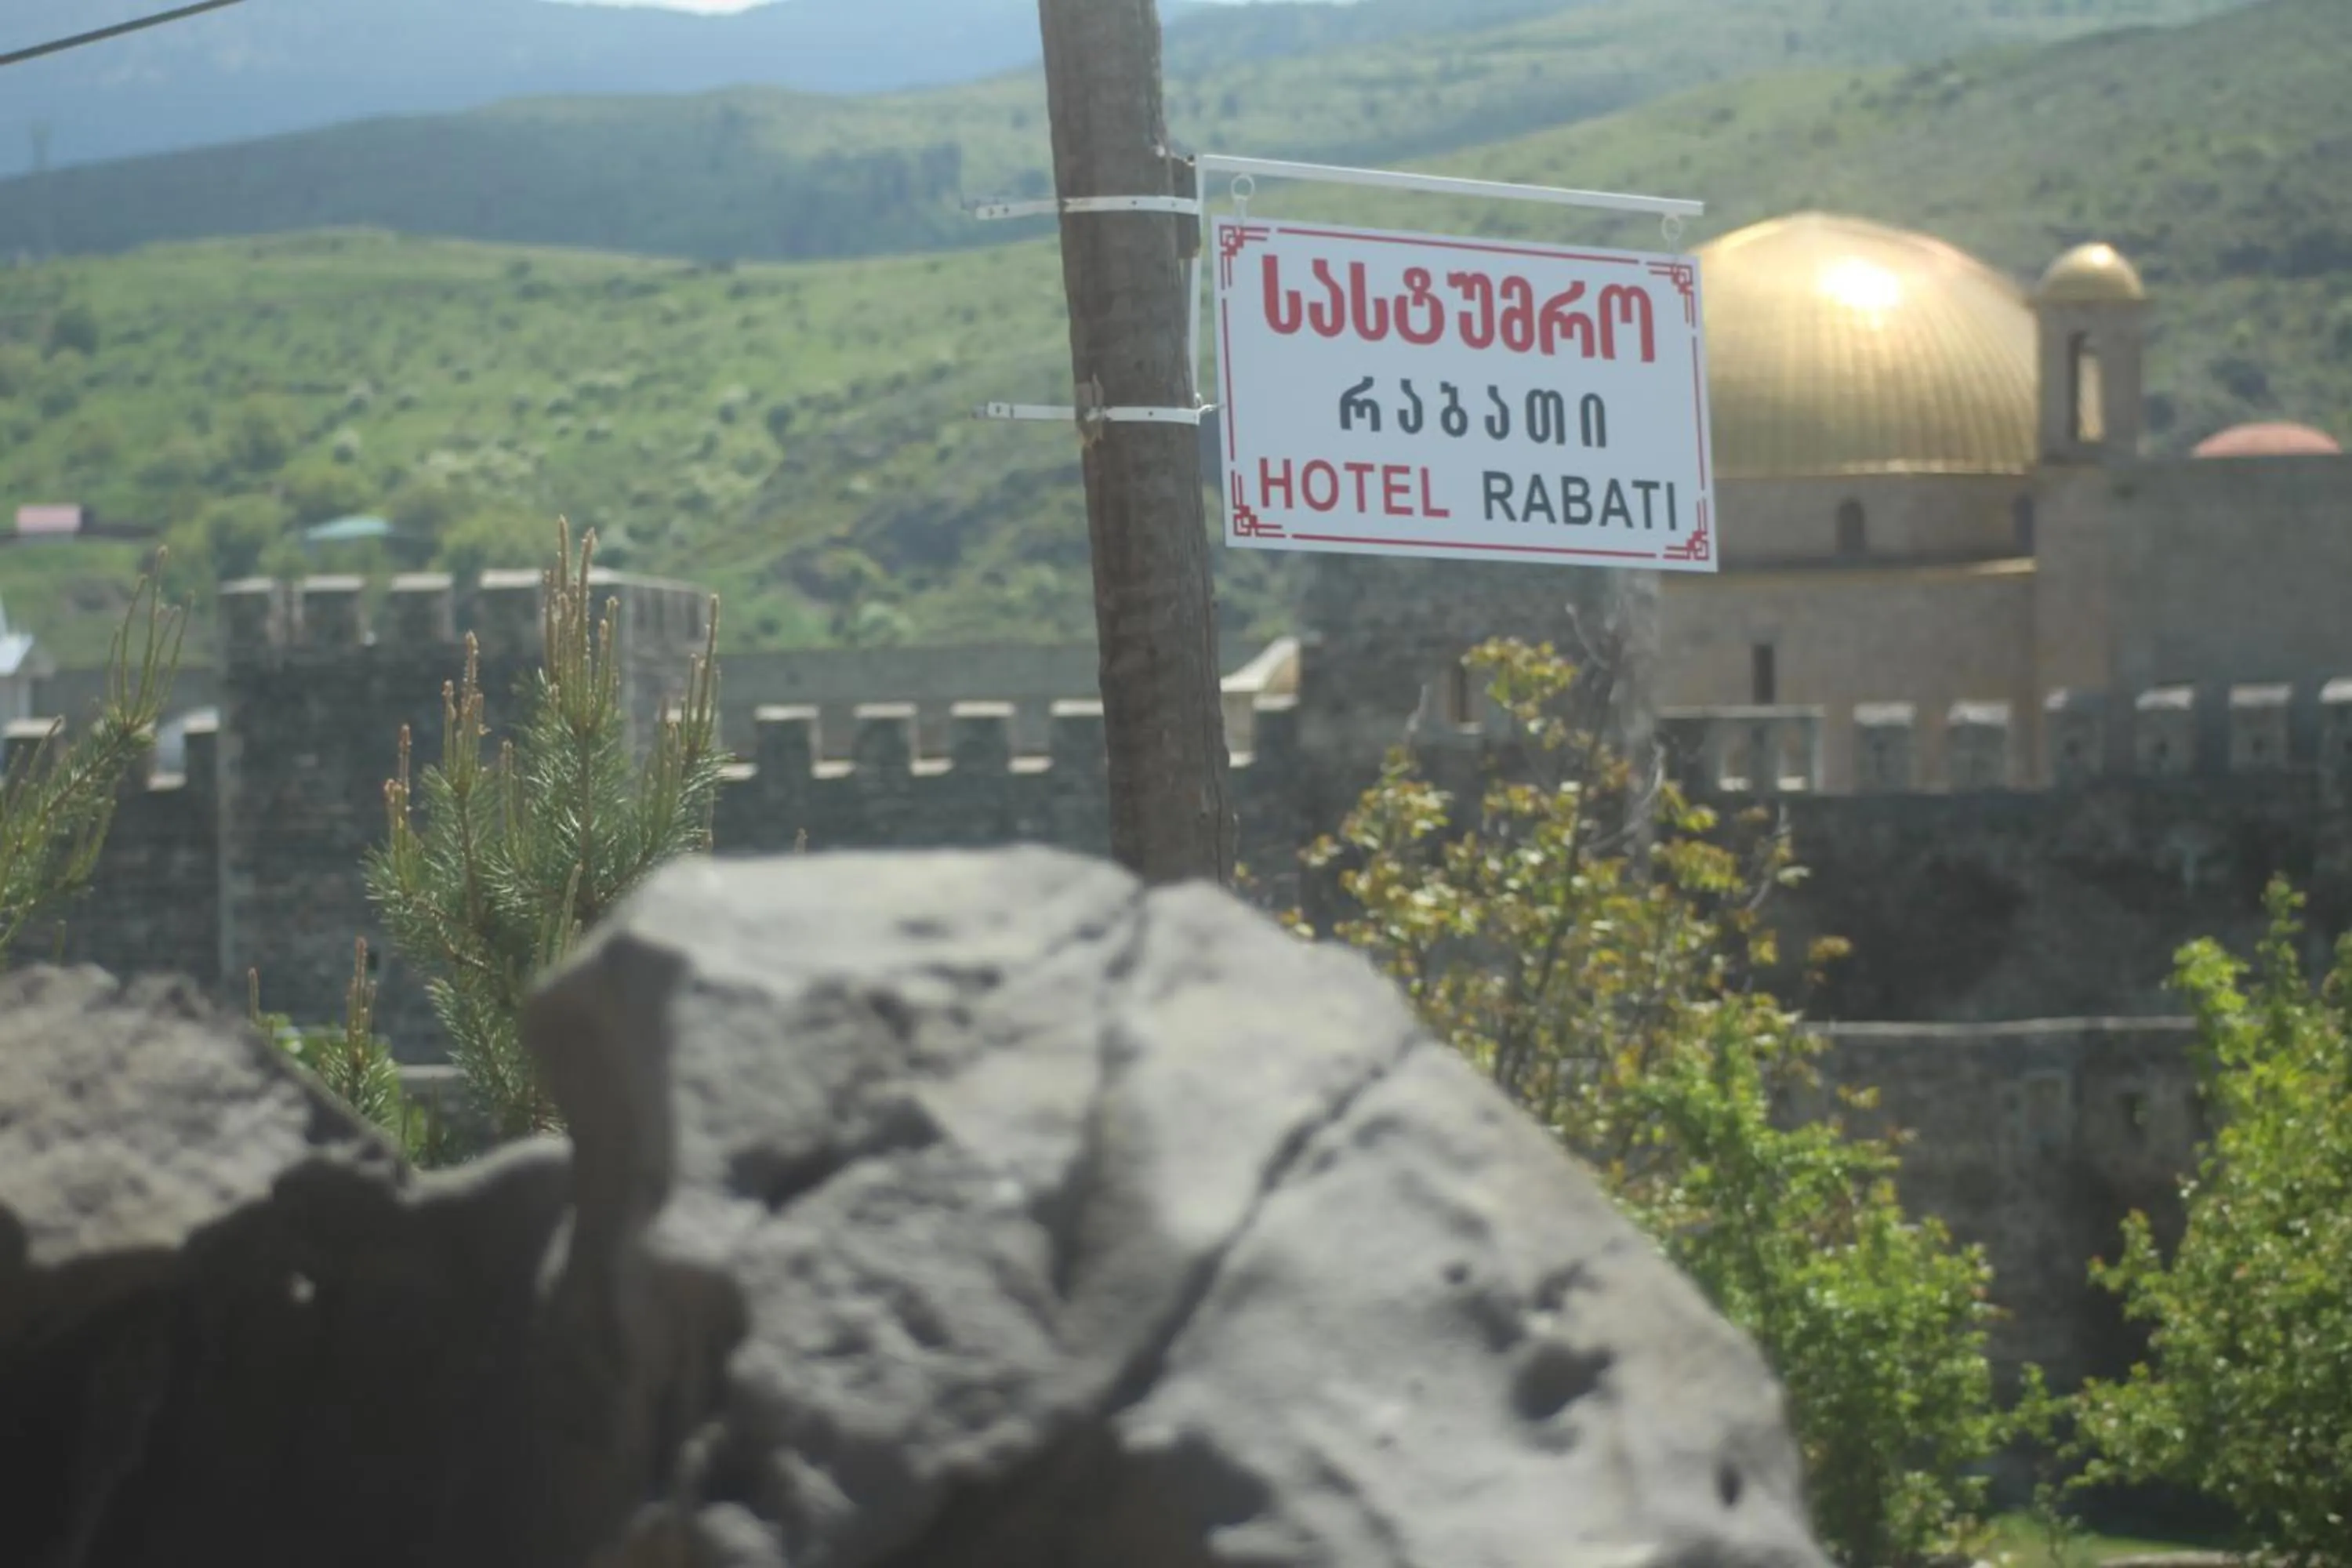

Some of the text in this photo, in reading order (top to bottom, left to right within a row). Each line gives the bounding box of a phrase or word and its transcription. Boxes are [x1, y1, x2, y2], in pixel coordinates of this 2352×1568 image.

[1261, 253, 1656, 364] სასტუმრო
[1338, 375, 1608, 449] რაბათი
[1258, 456, 1678, 532] HOTEL RABATI
